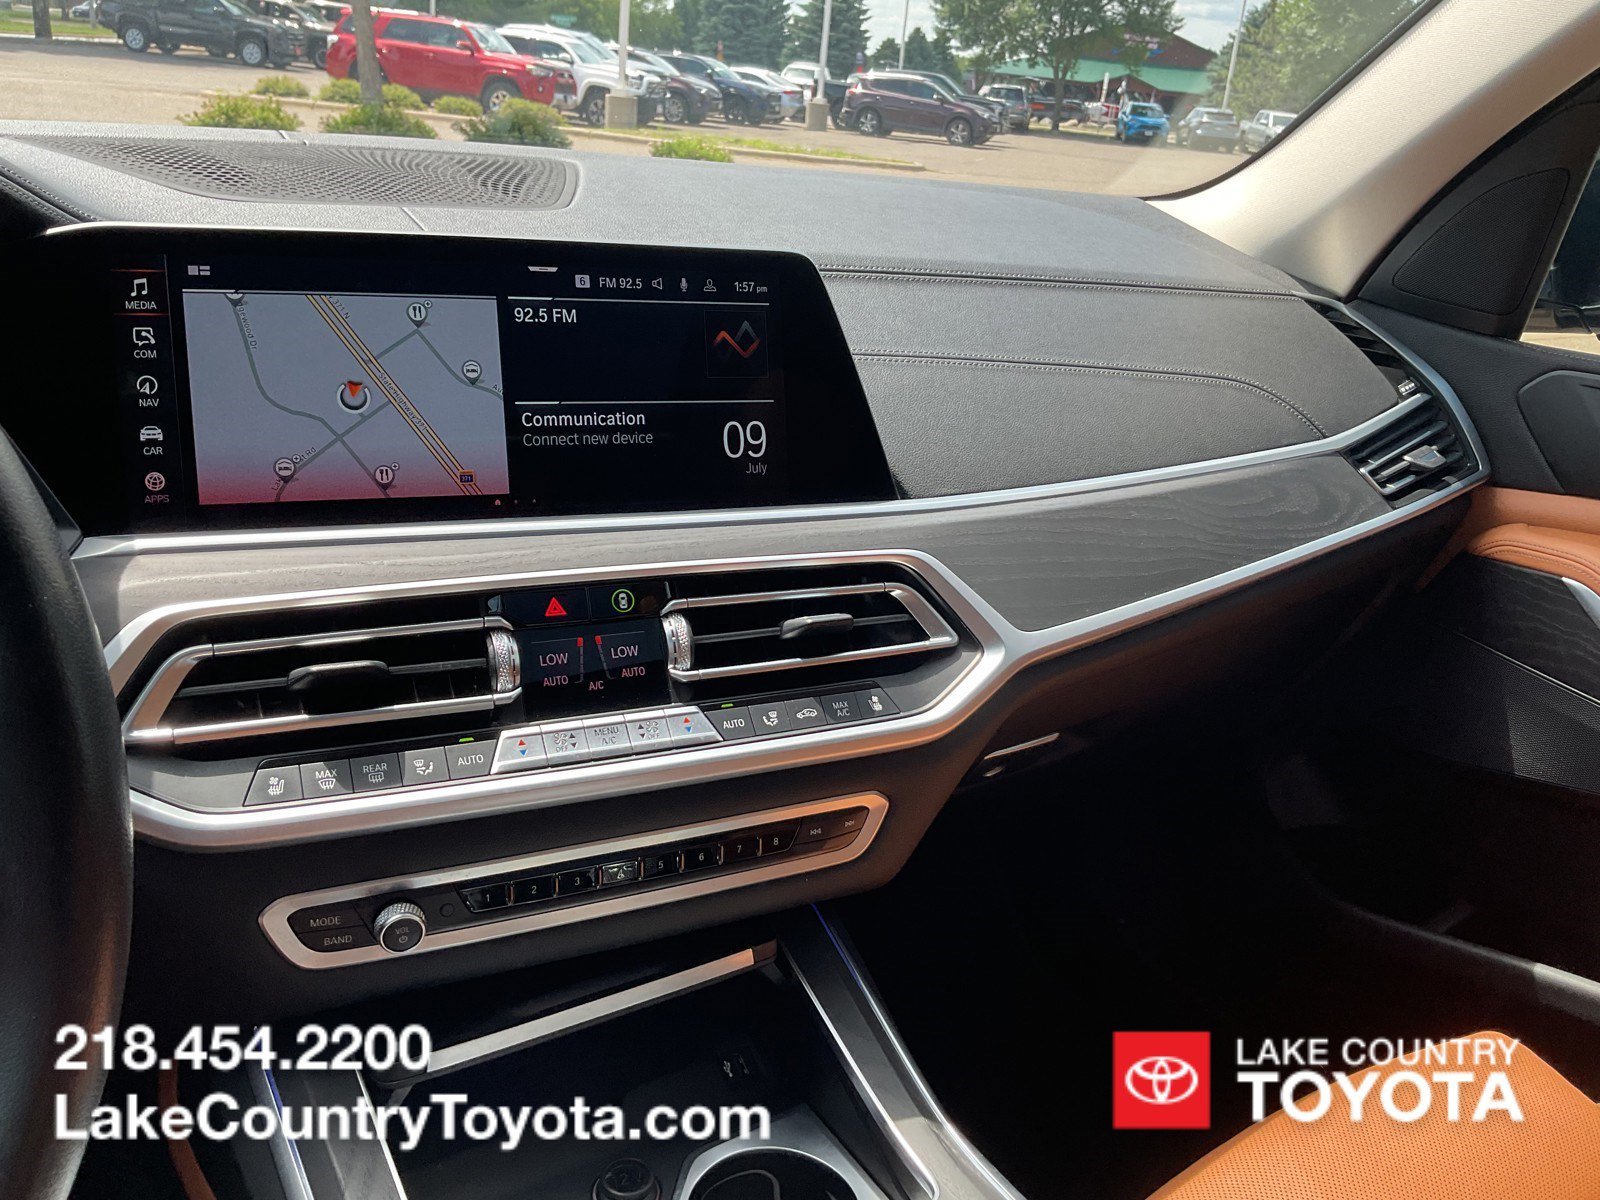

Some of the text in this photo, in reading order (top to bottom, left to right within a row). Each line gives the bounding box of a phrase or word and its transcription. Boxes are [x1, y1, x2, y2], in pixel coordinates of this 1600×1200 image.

[579, 276, 643, 289] 6 FM 92.5
[734, 281, 768, 294] 1:57 pm
[125, 300, 157, 310] MEDIA
[514, 307, 577, 323] 92.5 FM
[133, 349, 157, 359] COM
[138, 398, 160, 407] NAV
[522, 411, 646, 428] Communication
[522, 431, 654, 447] Connect new device
[723, 420, 767, 459] 09
[143, 446, 163, 456] CAR
[745, 462, 768, 476] July
[144, 494, 170, 504] APPS
[610, 645, 639, 659] LOW
[539, 653, 569, 668] LOW
[621, 666, 646, 678] AUTO
[543, 675, 569, 687] AUTO
[588, 680, 604, 691] A/C
[832, 701, 849, 709] MAX
[837, 708, 851, 717] A/C
[723, 718, 745, 730] AUTO
[594, 726, 620, 737] MENU
[601, 736, 617, 746] A/C
[457, 753, 484, 767] AUTO
[315, 768, 338, 779] MAX
[363, 762, 388, 774] REAR
[531, 885, 538, 894] 2
[574, 876, 581, 887] 3
[658, 860, 664, 870] 5
[698, 853, 705, 862] 6
[737, 845, 743, 854] 7
[773, 837, 779, 846] 8
[310, 915, 342, 928] MODE
[323, 934, 352, 946] BAND
